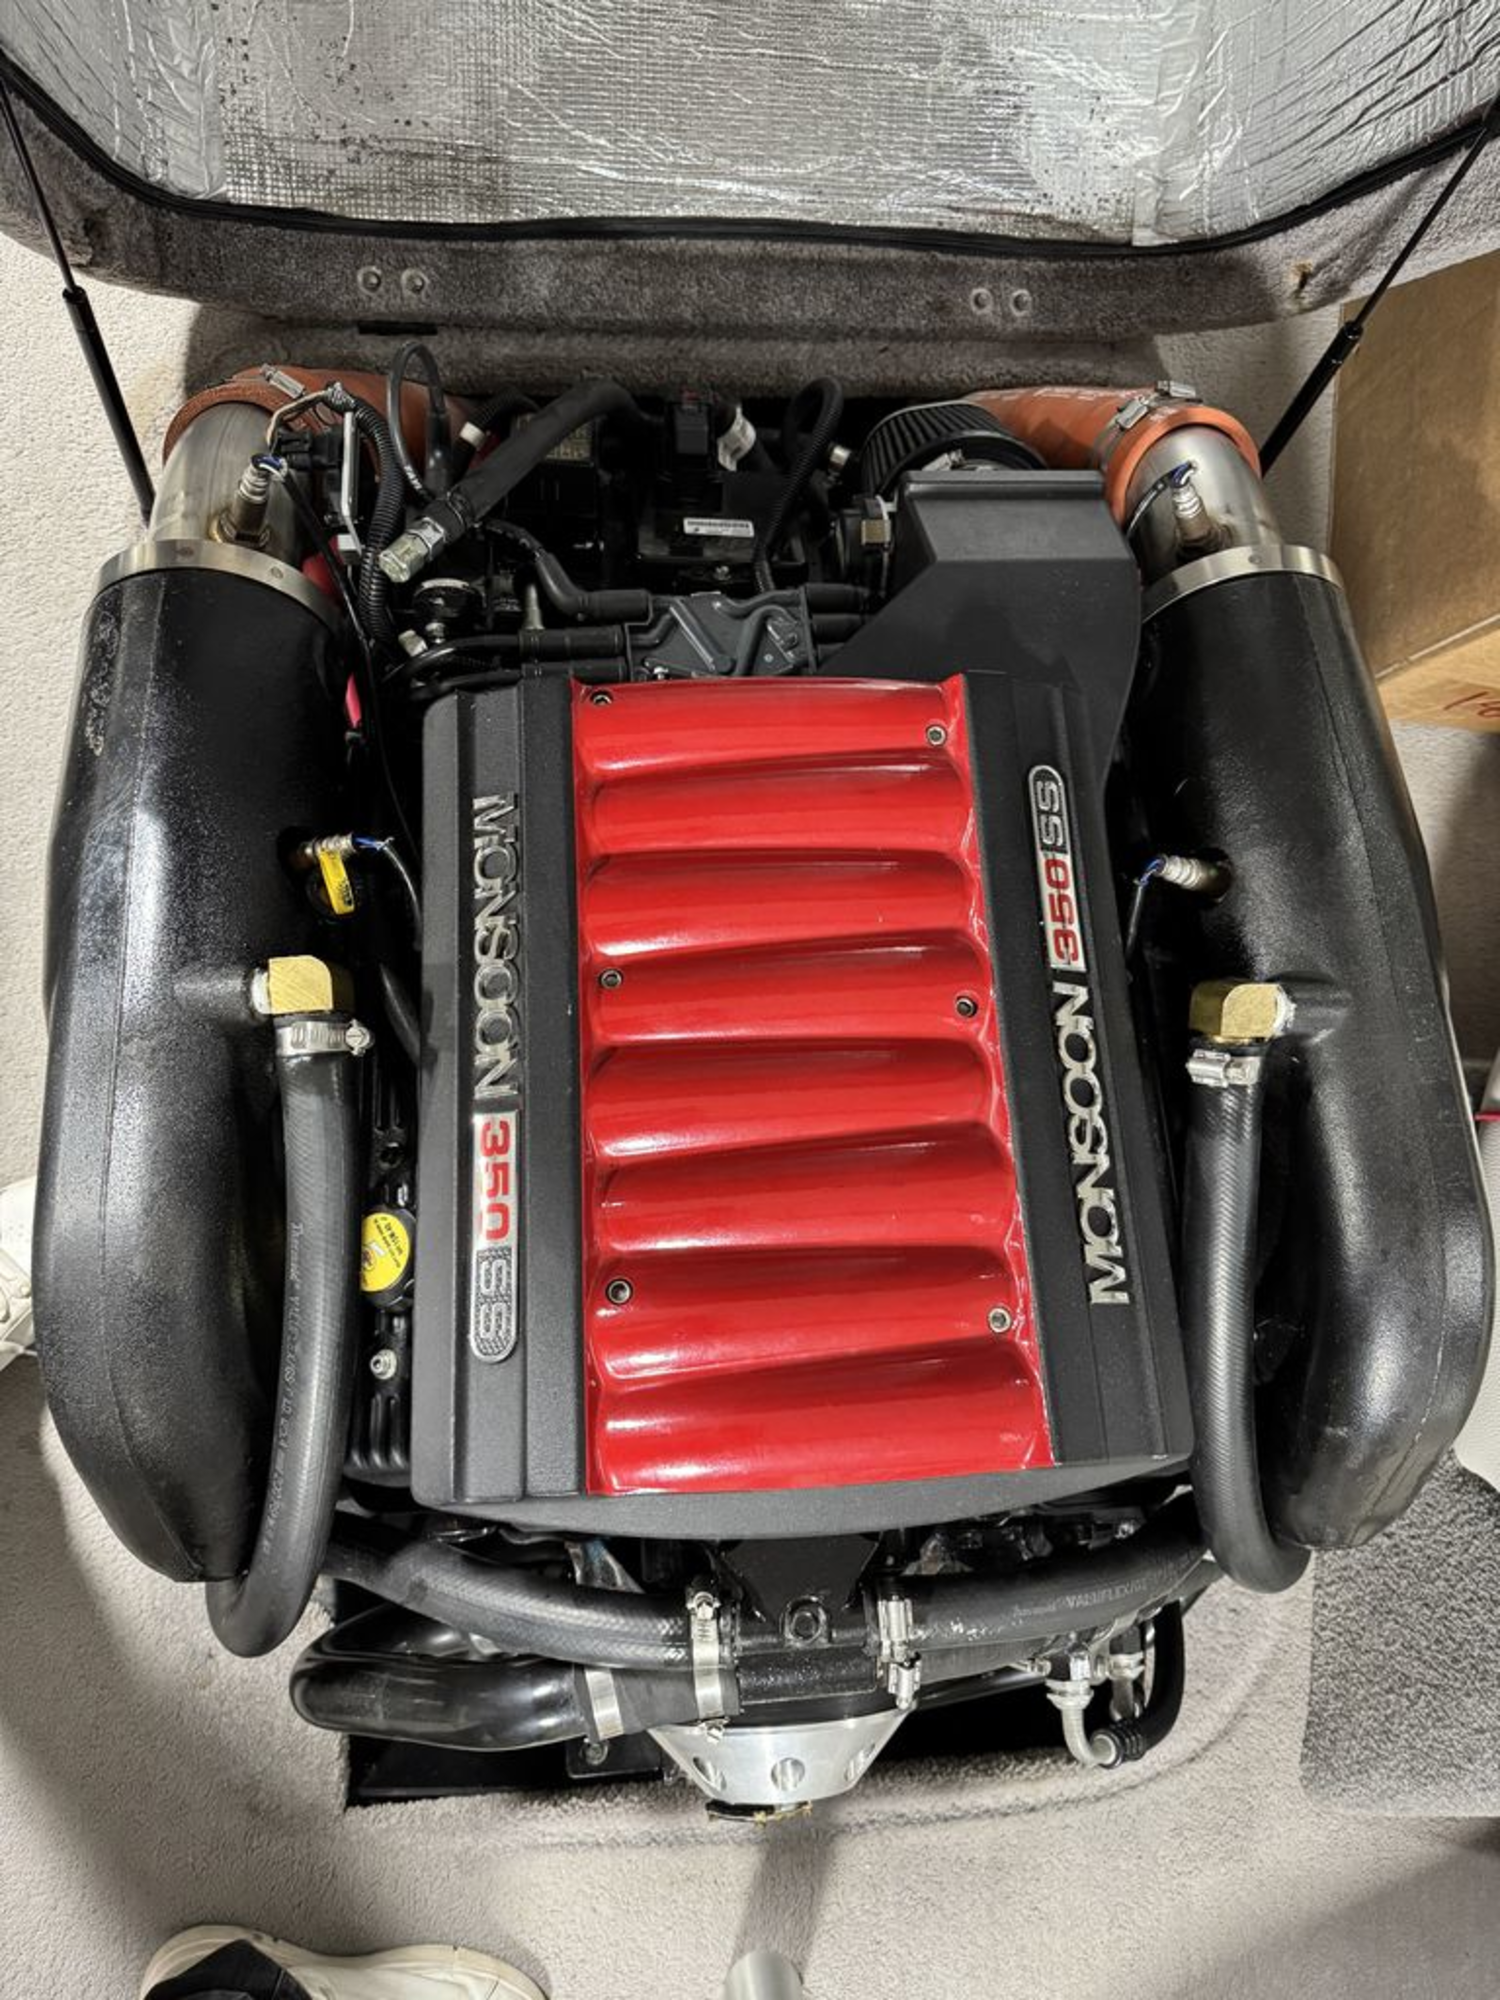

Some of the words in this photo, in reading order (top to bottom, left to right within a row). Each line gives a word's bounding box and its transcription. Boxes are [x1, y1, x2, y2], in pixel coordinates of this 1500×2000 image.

[1036, 780, 1063, 847] SS
[473, 793, 518, 1100] MONSOON
[1044, 857, 1080, 963] 350
[477, 1120, 511, 1240] 350
[1053, 981, 1129, 1304] MONSOON
[480, 1257, 508, 1339] SS
